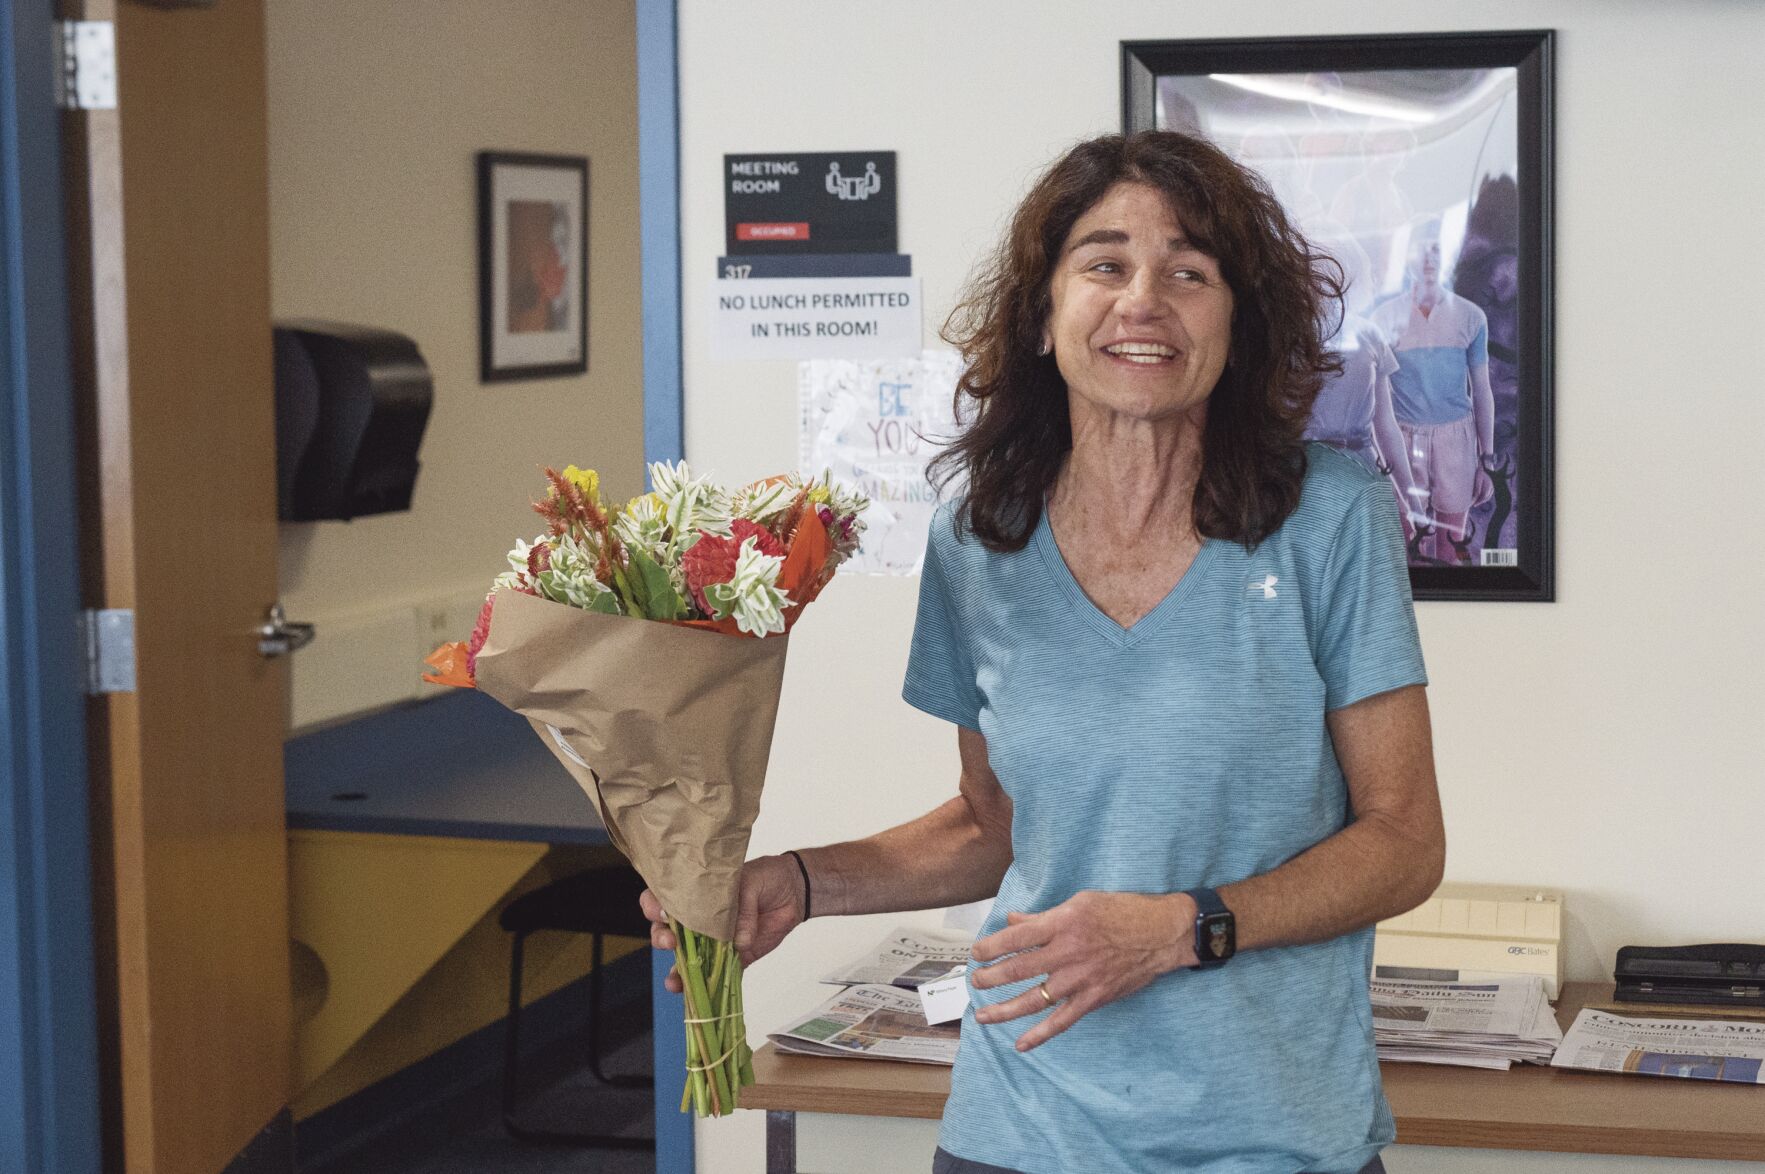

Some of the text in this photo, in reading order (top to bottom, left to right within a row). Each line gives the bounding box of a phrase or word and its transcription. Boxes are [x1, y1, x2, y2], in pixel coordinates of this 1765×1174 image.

[731, 161, 799, 176] MEETING
[731, 180, 780, 194] ROOM
[725, 264, 752, 279] 317
[719, 292, 910, 310] NO LUNCH PERMITTED
[751, 321, 878, 337] IN THIS ROOM!
[879, 382, 912, 416] BE
[867, 419, 922, 456] YOU
[859, 480, 935, 504] MAZING
[1591, 1015, 1697, 1031] CONCORD
